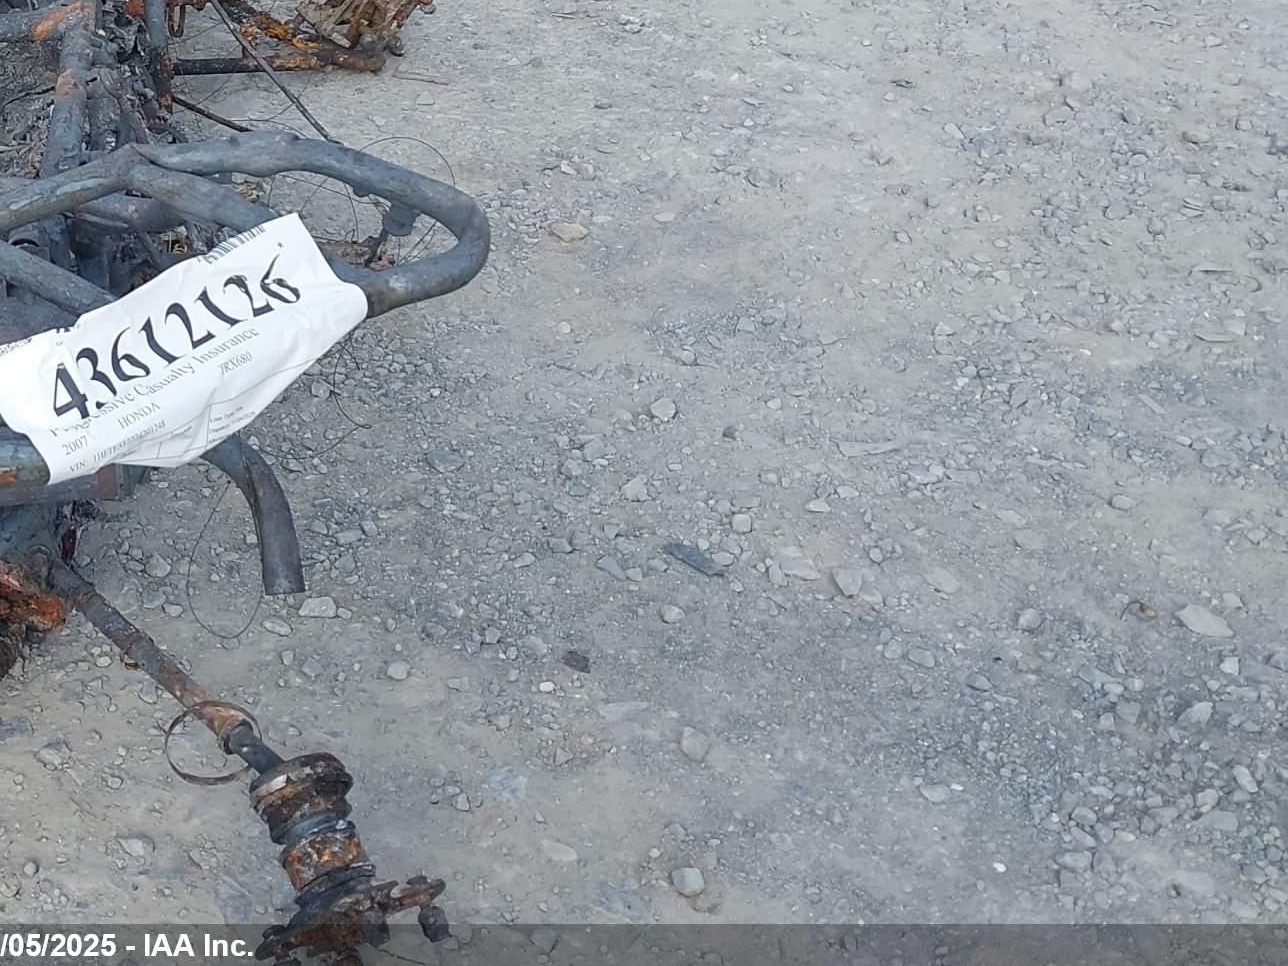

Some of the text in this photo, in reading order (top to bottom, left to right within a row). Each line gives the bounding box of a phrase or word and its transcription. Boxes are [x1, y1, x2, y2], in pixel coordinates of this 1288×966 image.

[53, 253, 302, 420] 43612126
[133, 362, 196, 406] Casualty
[195, 327, 260, 372] Insurance
[61, 434, 90, 457] 2007
[117, 401, 161, 430] HONDA
